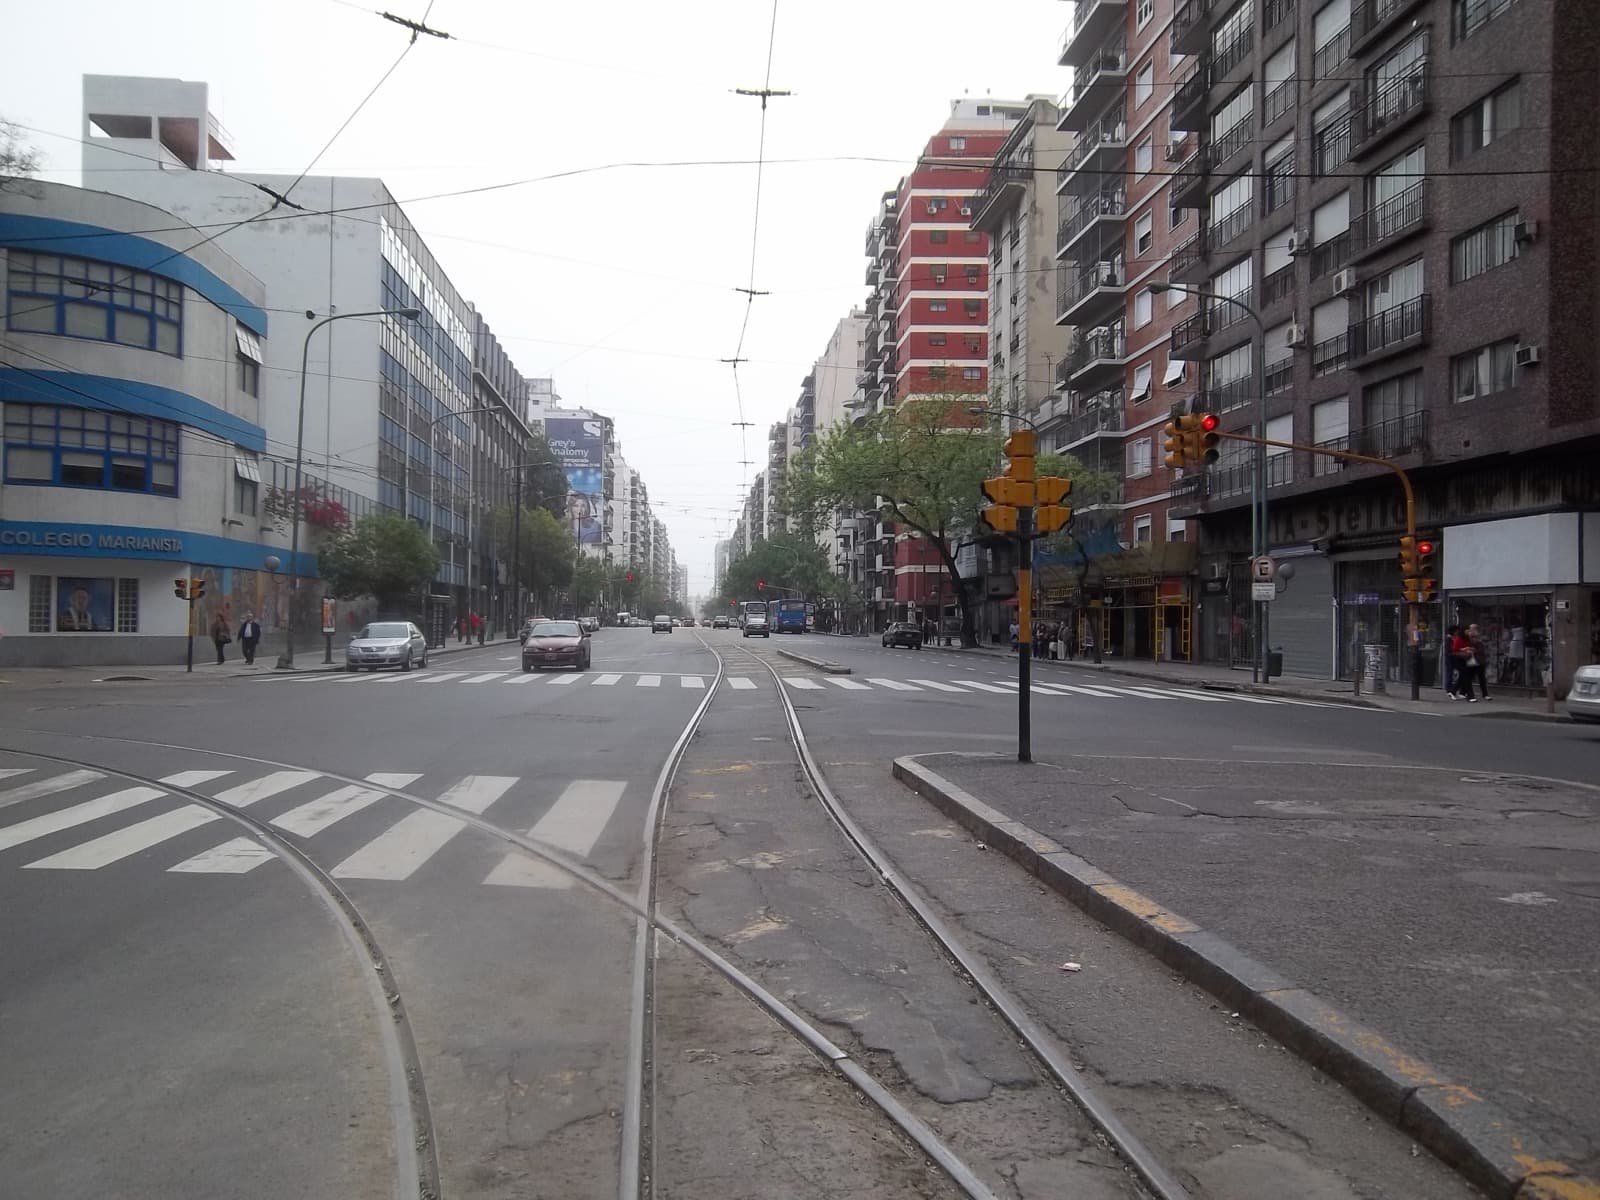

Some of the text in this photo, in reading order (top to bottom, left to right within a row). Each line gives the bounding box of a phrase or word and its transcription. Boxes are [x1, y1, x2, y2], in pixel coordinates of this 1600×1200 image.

[547, 438, 576, 449] Grey's
[1, 531, 183, 552] COLEGIO MARIANISTA
